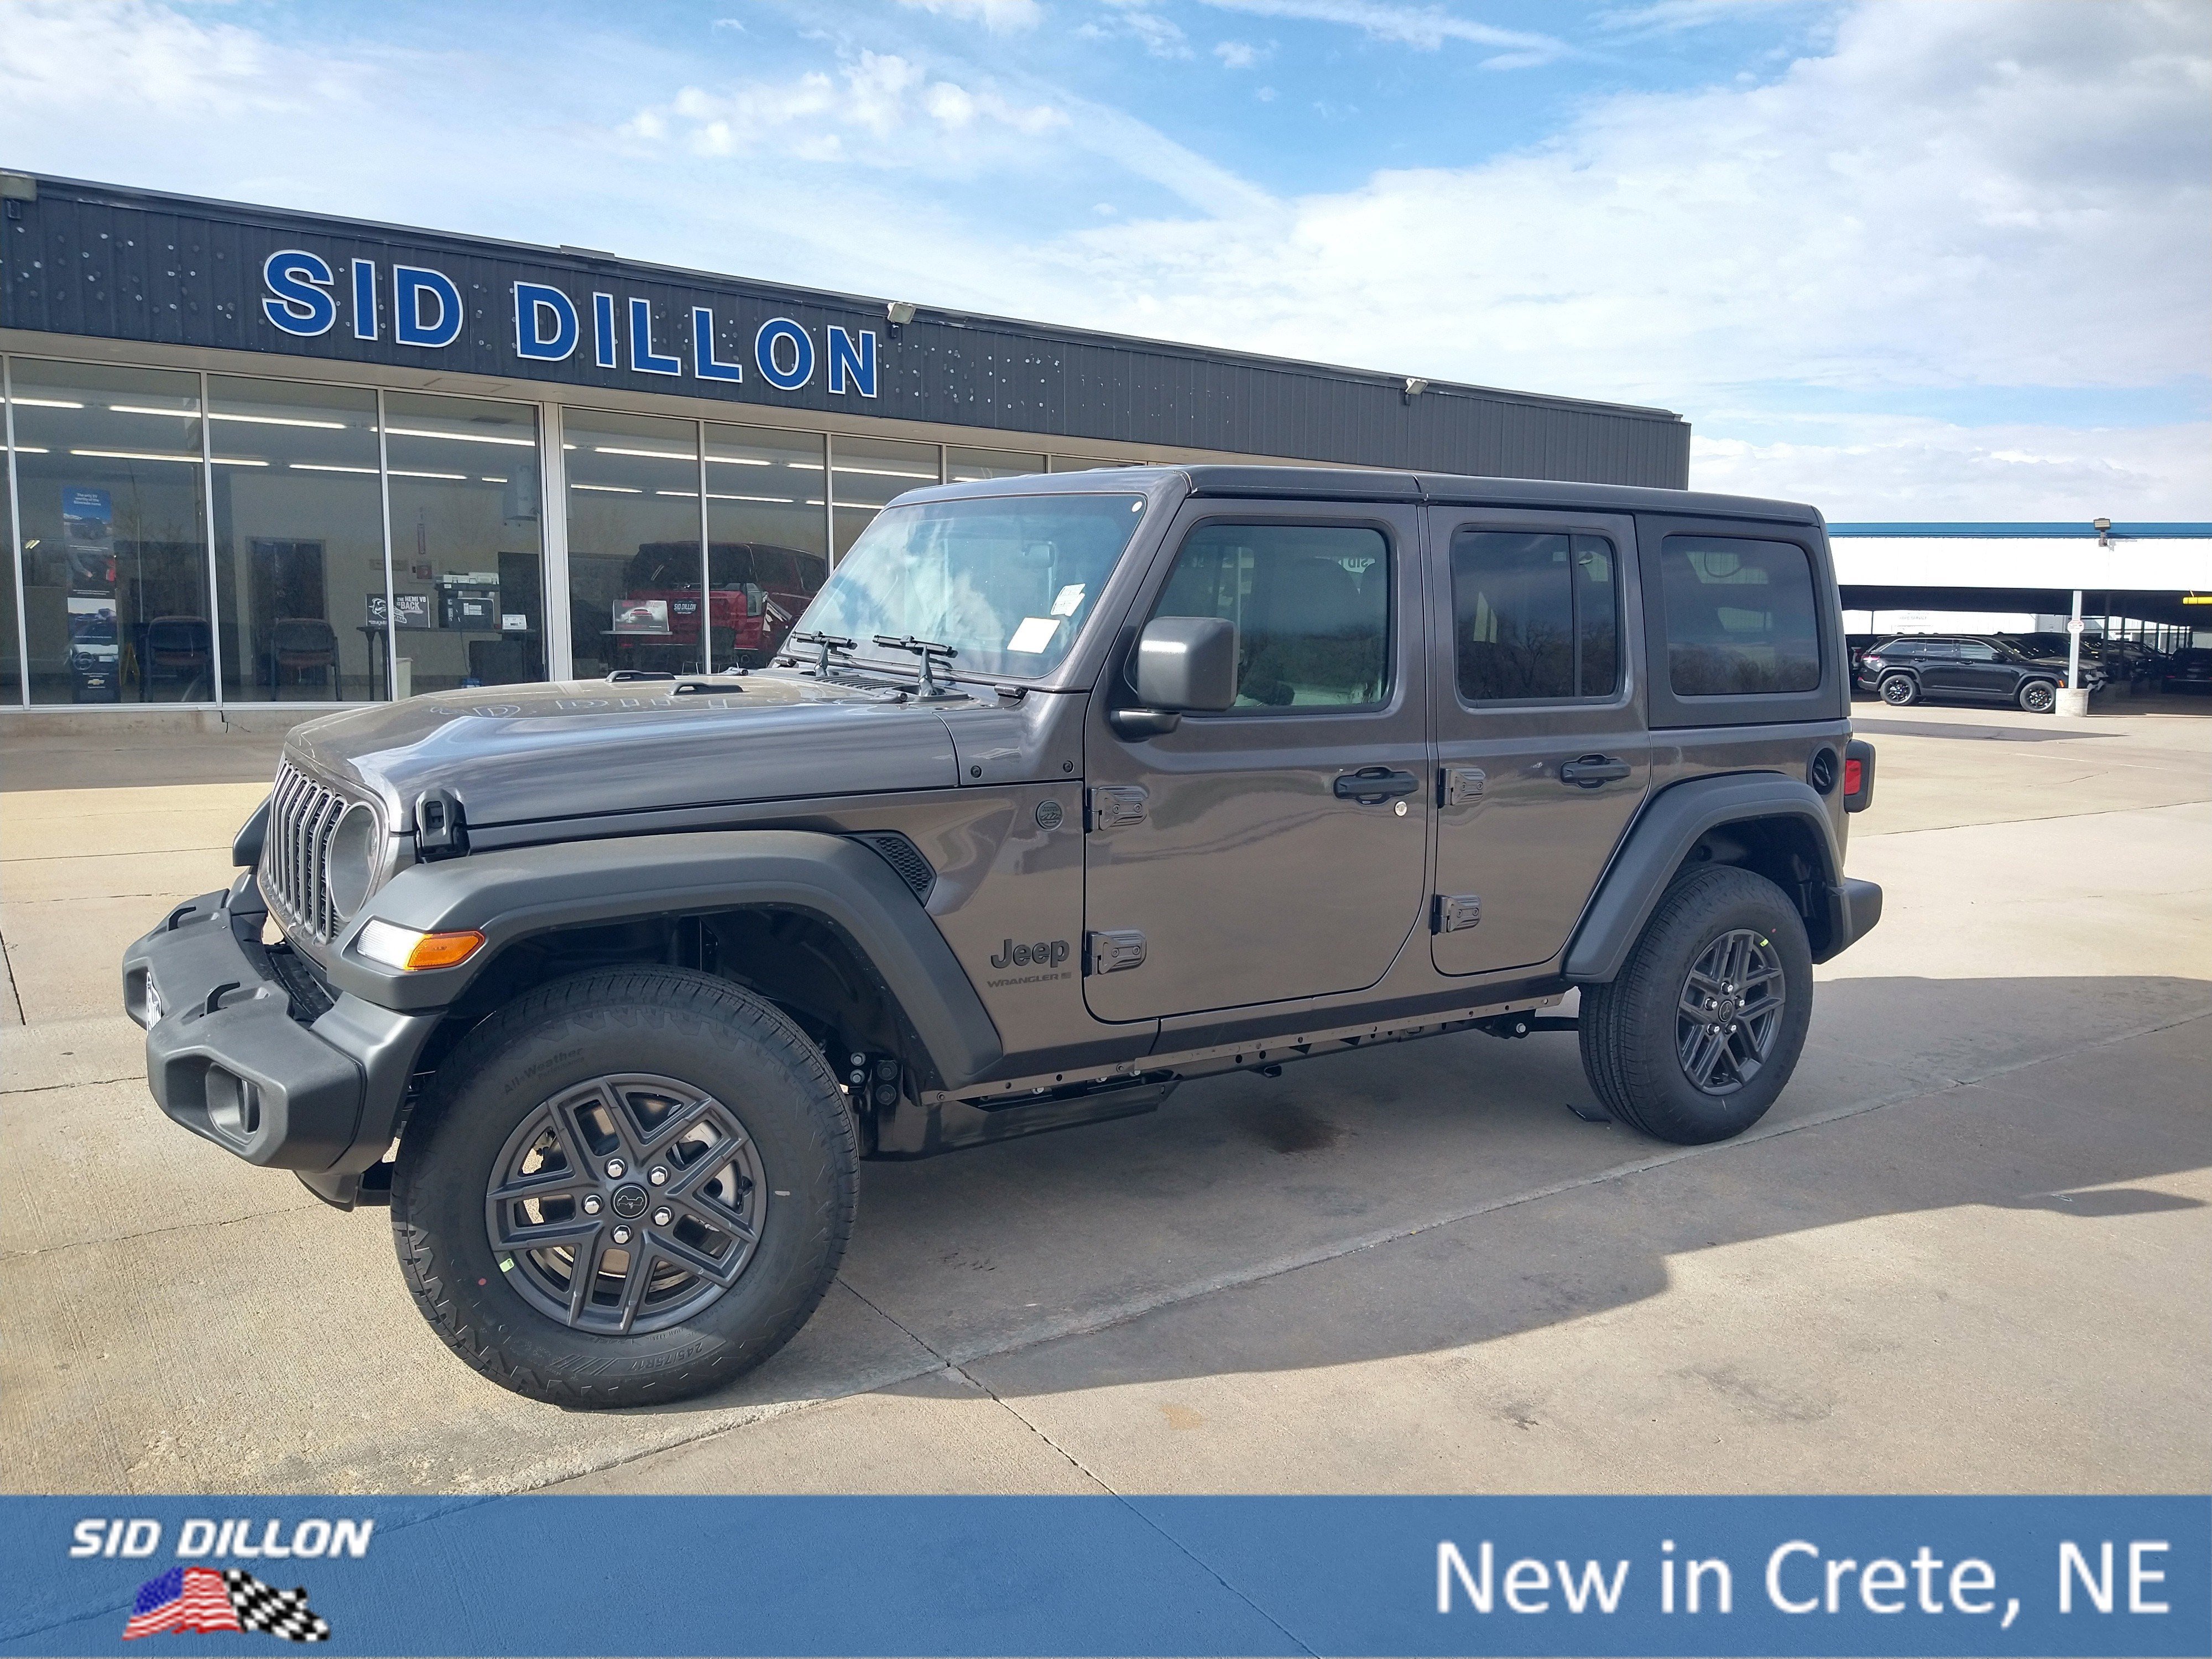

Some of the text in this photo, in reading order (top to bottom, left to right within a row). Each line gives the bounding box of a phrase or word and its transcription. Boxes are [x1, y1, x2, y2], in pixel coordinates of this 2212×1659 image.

[262, 249, 878, 399] SID DILLON
[400, 601, 420, 611] BACK
[990, 938, 1070, 969] Jeep
[987, 973, 1059, 988] WRANGLER
